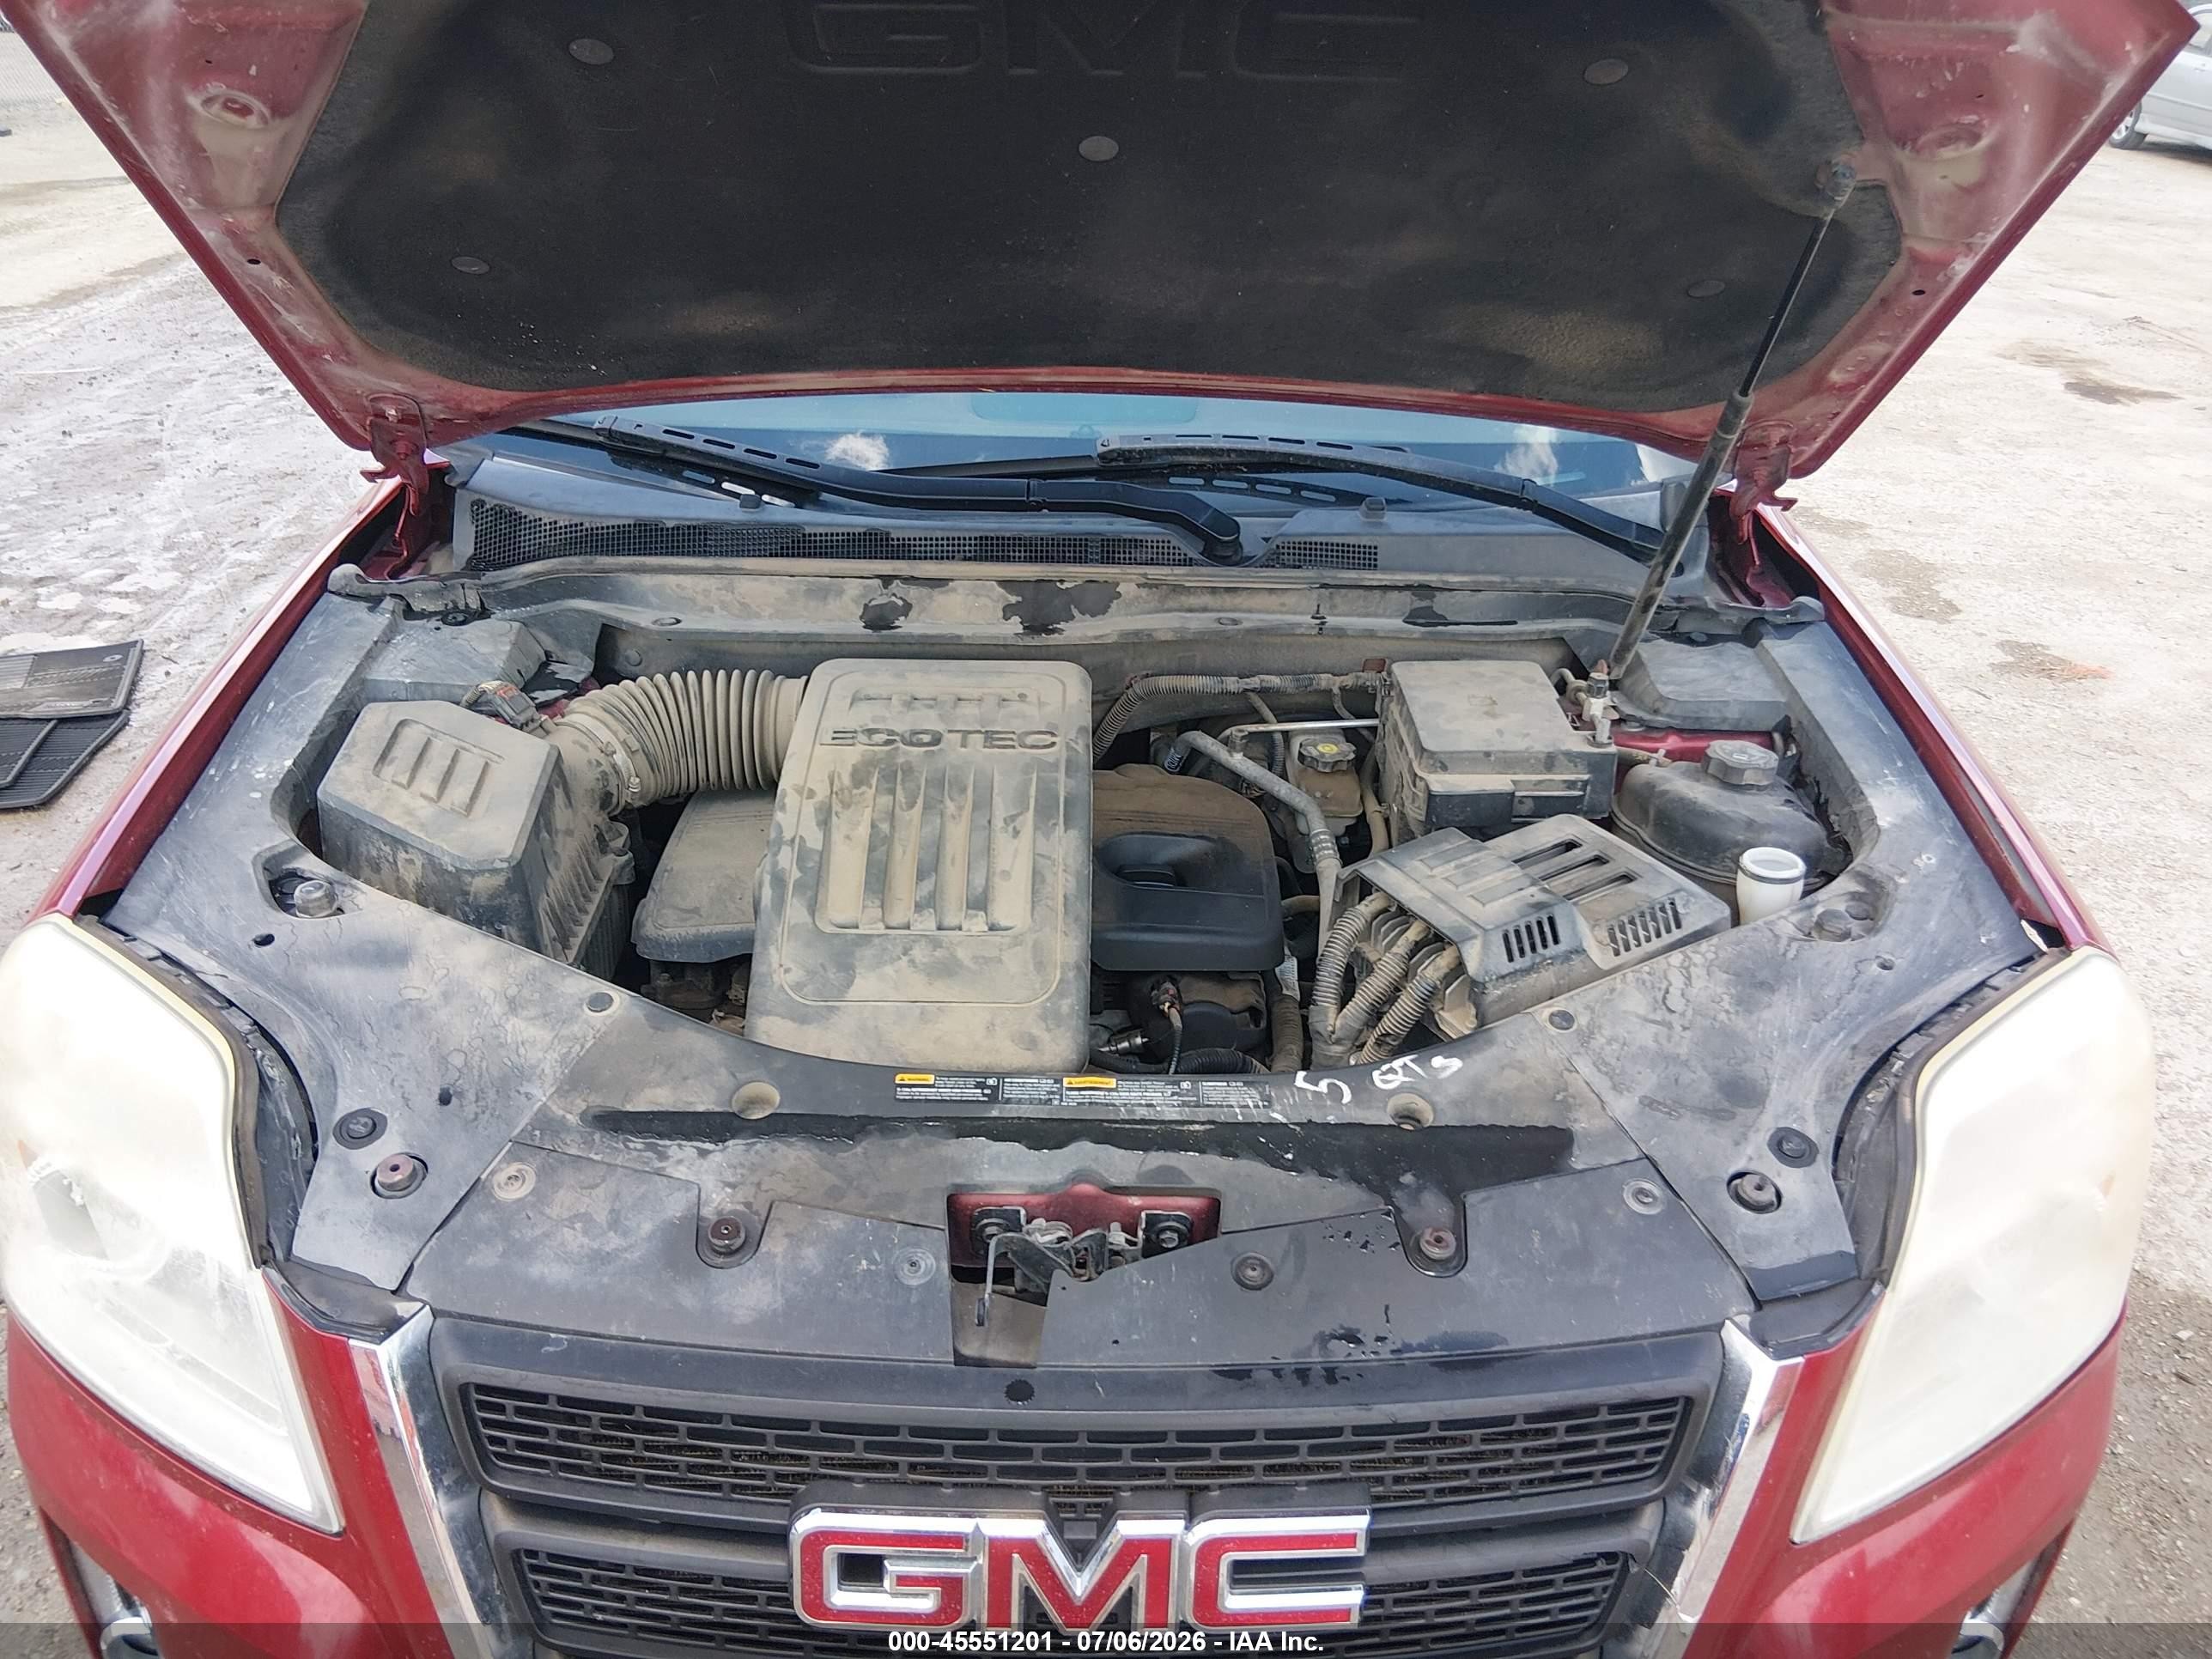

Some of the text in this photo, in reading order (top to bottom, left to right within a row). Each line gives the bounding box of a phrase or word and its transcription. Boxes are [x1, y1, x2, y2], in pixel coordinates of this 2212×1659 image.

[785, 0, 1424, 83] GMC
[819, 727, 1058, 750] ECOTEC
[1294, 1071, 1352, 1104] 5
[792, 1508, 1371, 1634] GMC
